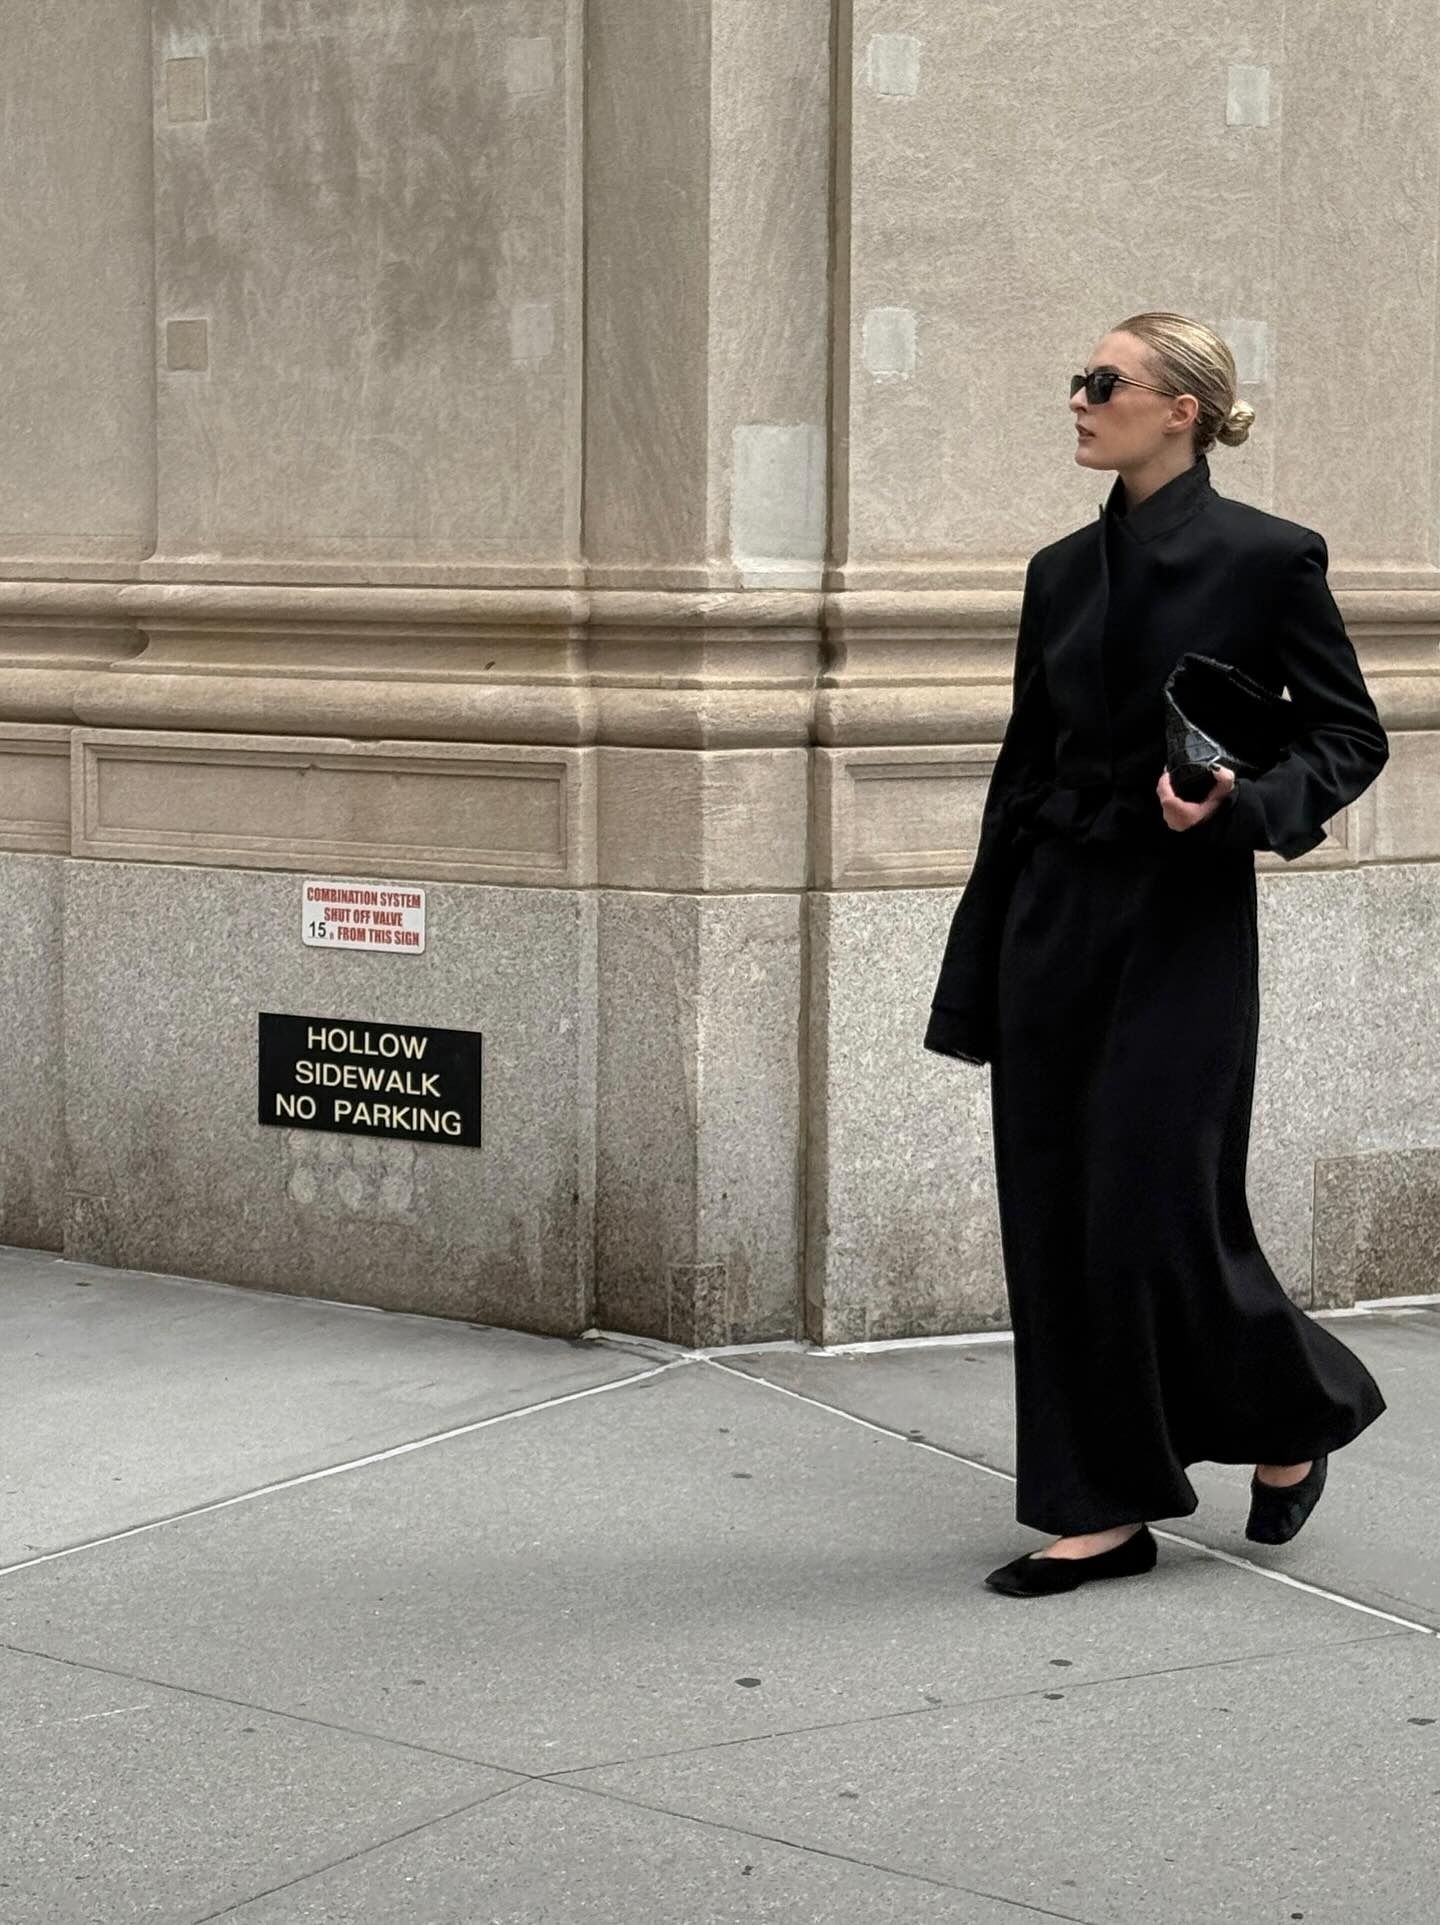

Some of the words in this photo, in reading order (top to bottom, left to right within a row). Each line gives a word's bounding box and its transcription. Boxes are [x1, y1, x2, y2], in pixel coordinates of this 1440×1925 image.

[307, 887, 378, 906] COMBINATION
[380, 892, 421, 909] SYSTEM
[324, 907, 351, 923] SHUT
[353, 909, 371, 925] OFF
[373, 911, 404, 927] VALVE
[308, 921, 327, 938] 15
[337, 926, 366, 943] FROM
[368, 928, 393, 945] THIS
[394, 931, 420, 947] SIGN
[307, 1026, 428, 1060] HOLLOW
[295, 1060, 441, 1098] SIDEWALK
[275, 1093, 317, 1120] NO
[334, 1099, 462, 1136] PARKING
